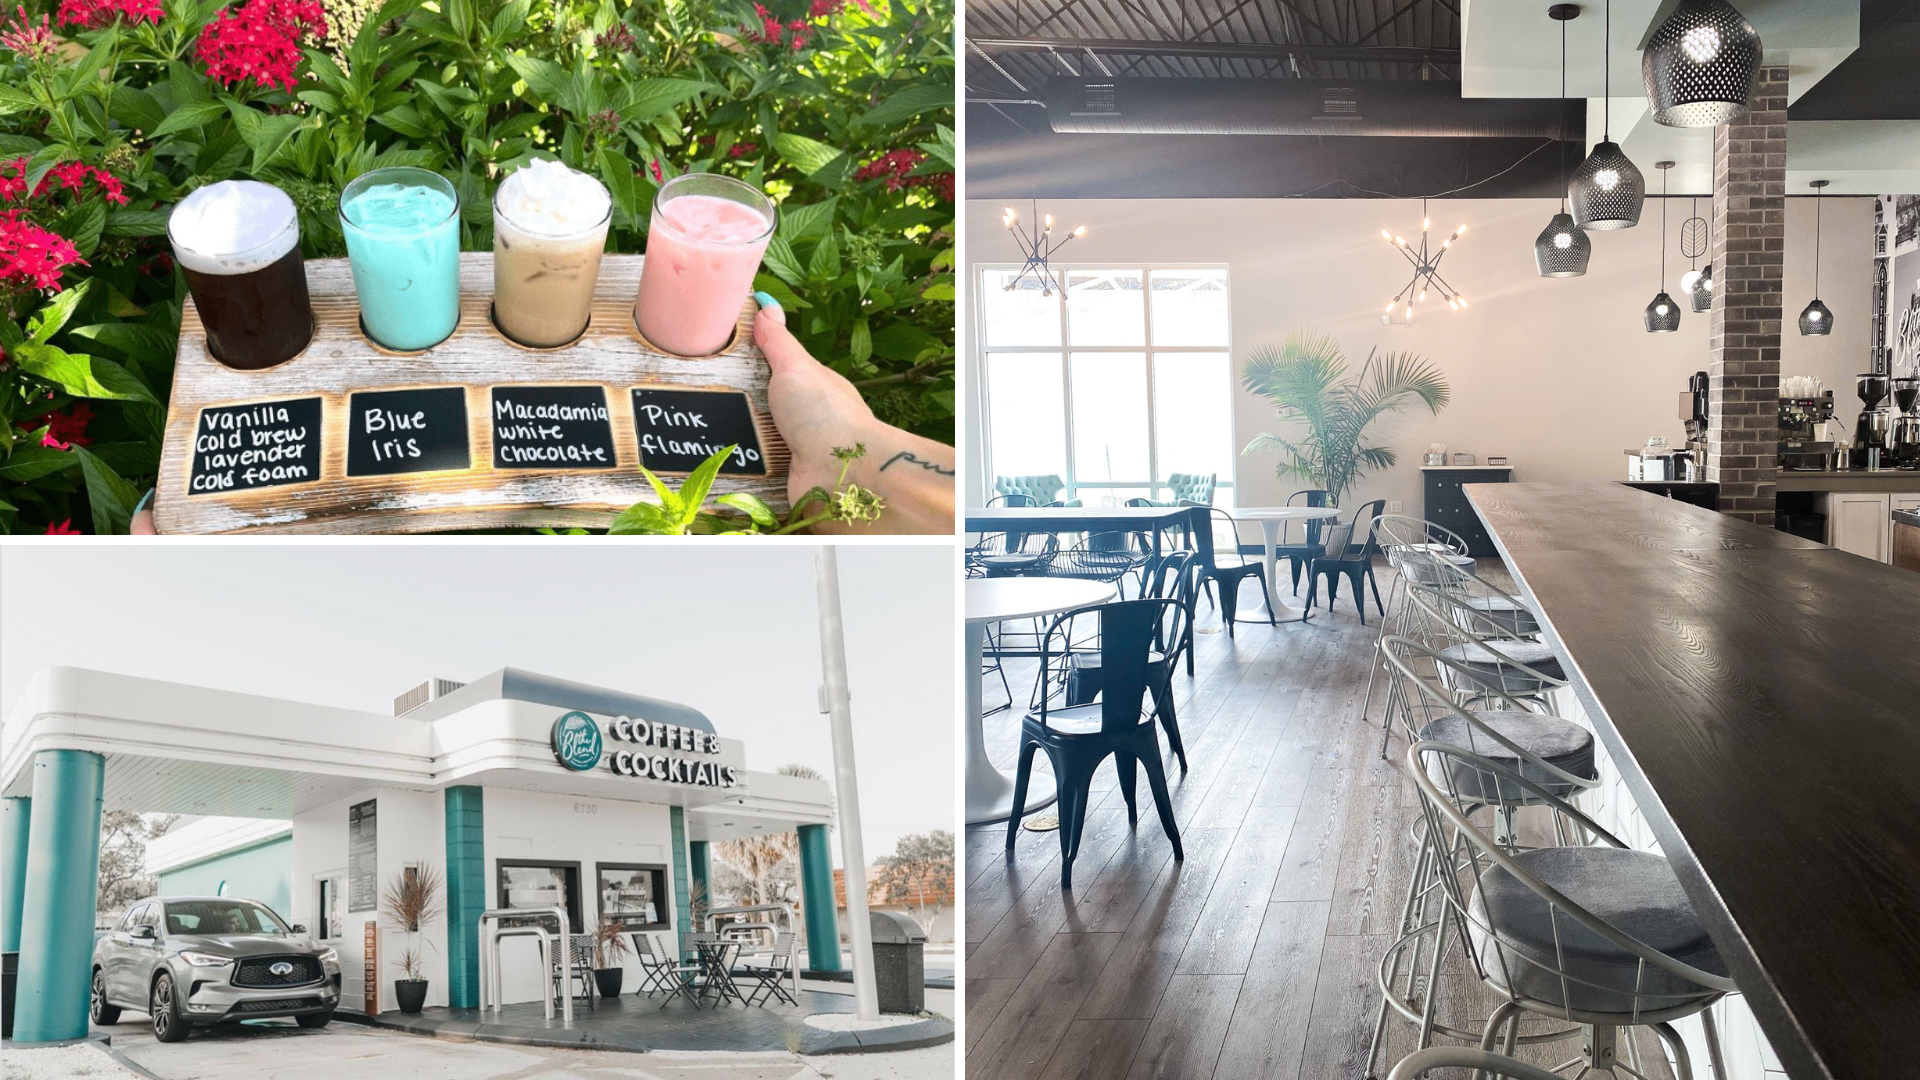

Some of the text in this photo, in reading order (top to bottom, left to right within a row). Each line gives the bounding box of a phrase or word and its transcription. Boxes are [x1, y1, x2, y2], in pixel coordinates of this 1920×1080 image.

[364, 408, 427, 434] Blue
[495, 399, 609, 421] Macadamia
[640, 404, 709, 428] Pink
[251, 426, 306, 446] brew
[498, 421, 564, 440] white
[204, 443, 306, 471] lavender
[371, 437, 422, 462] Iris
[242, 464, 308, 485] foam
[562, 730, 597, 761] Blend
[577, 728, 592, 745] the
[611, 715, 722, 755] COFFEE &
[611, 749, 738, 788] COCKTAILS
